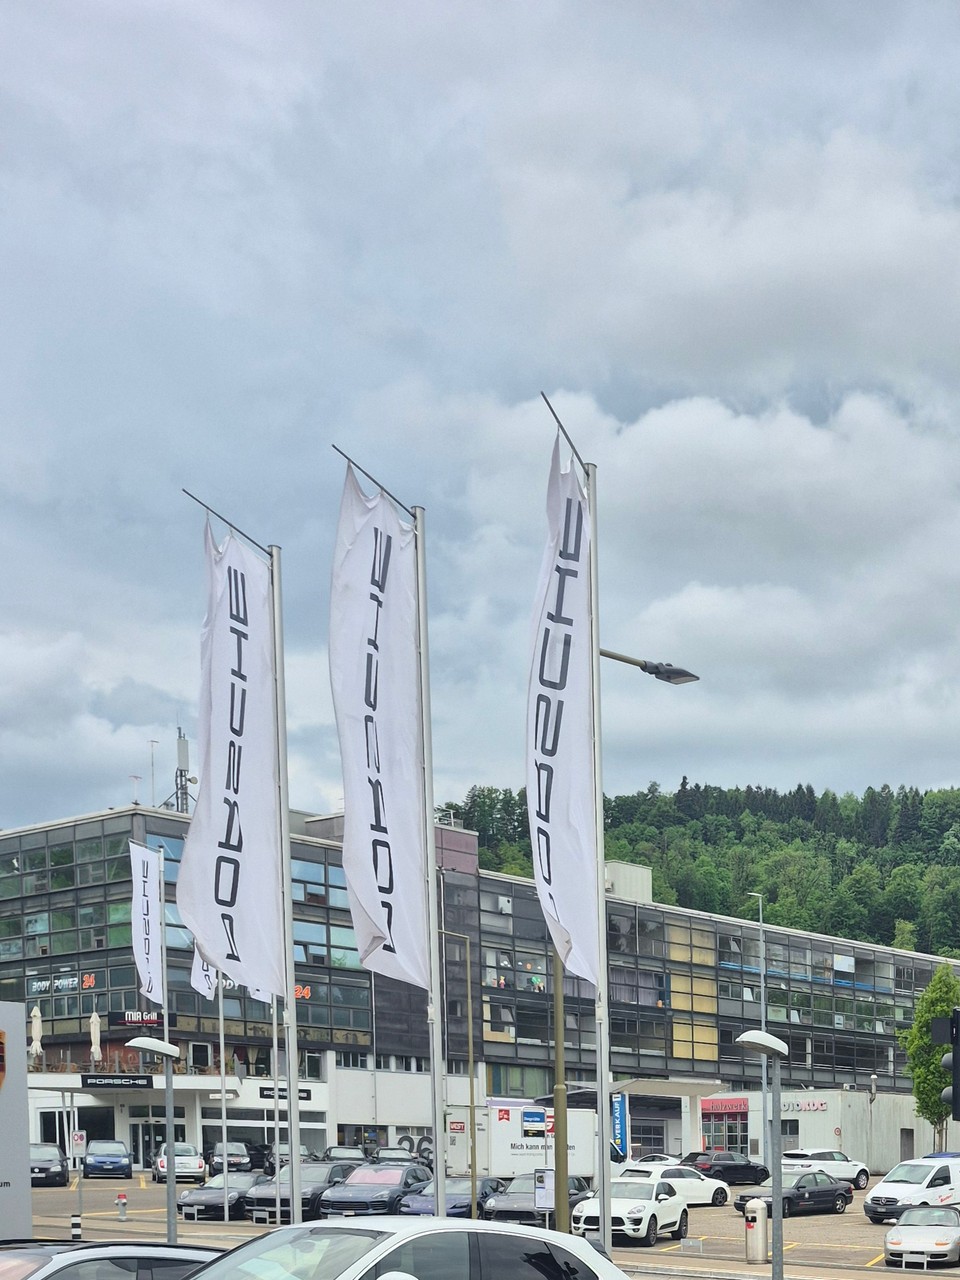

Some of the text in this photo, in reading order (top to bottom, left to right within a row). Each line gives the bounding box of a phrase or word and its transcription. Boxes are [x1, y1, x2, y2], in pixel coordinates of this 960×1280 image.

[31, 973, 95, 992] BODY POWER 24
[294, 985, 311, 999] 24
[143, 1011, 158, 1020] Grill
